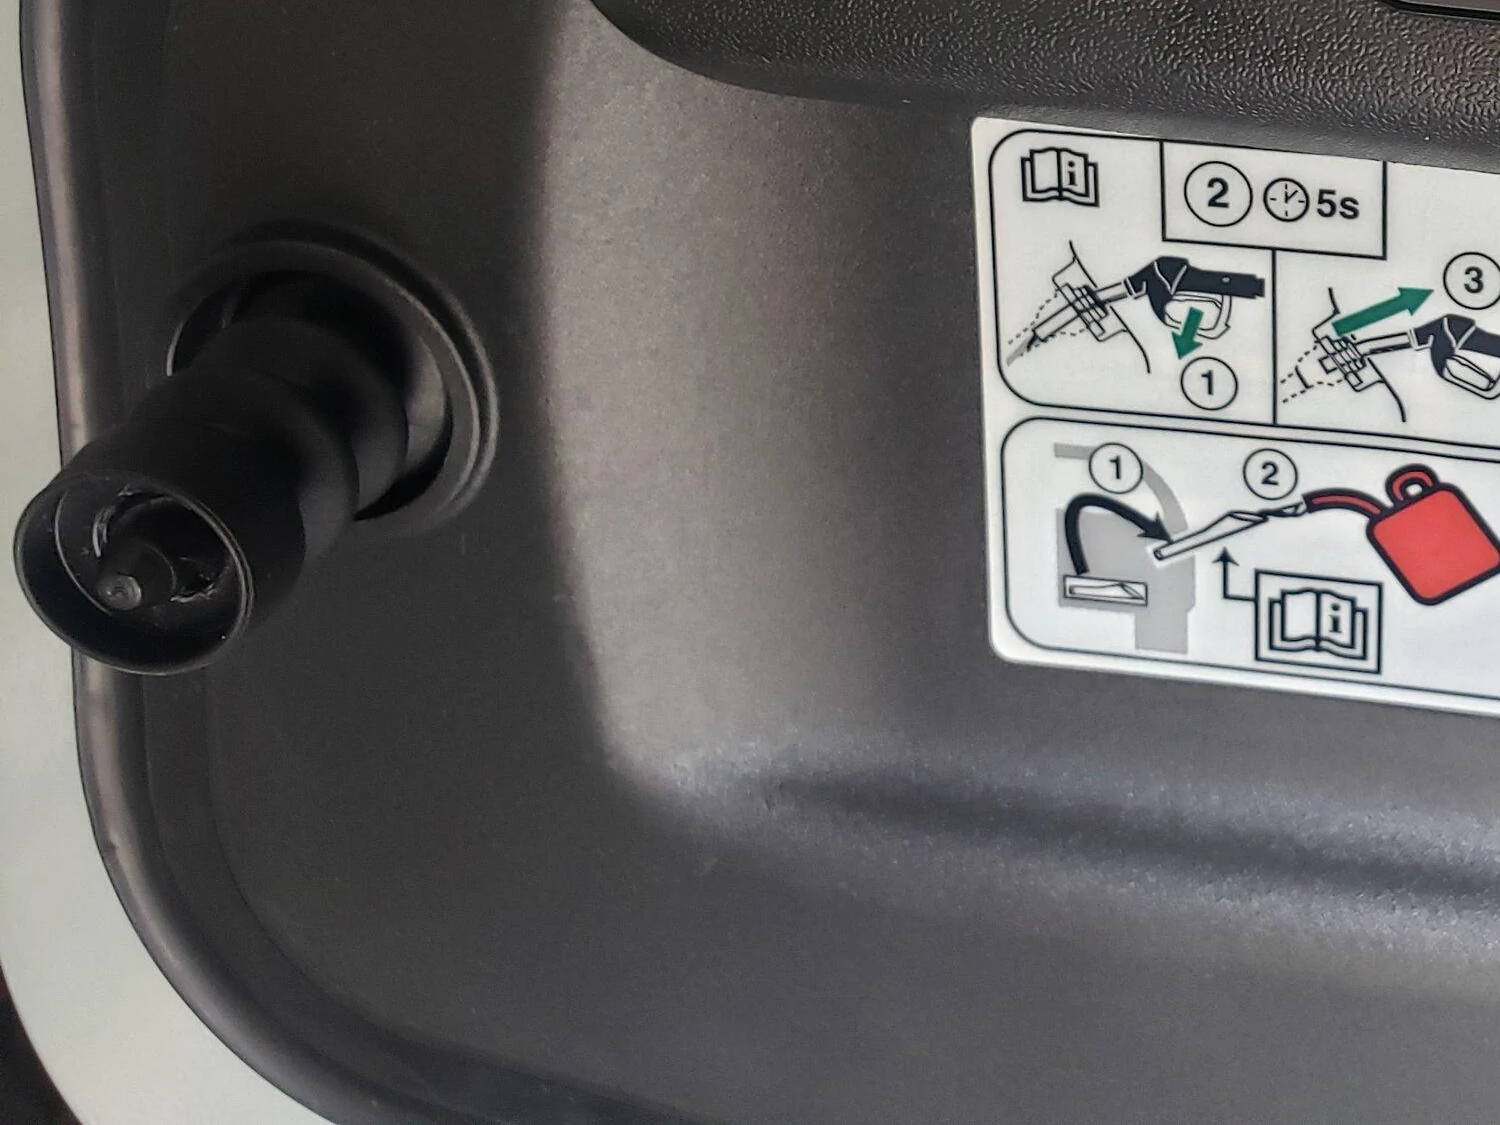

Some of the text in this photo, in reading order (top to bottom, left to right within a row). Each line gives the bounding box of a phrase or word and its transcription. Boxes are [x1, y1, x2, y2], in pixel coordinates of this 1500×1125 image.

[1205, 175, 1361, 221] 2 5s
[1462, 264, 1486, 296] 3
[1199, 368, 1216, 397] 1
[1108, 454, 1124, 481] 1
[1259, 459, 1280, 487] 2
